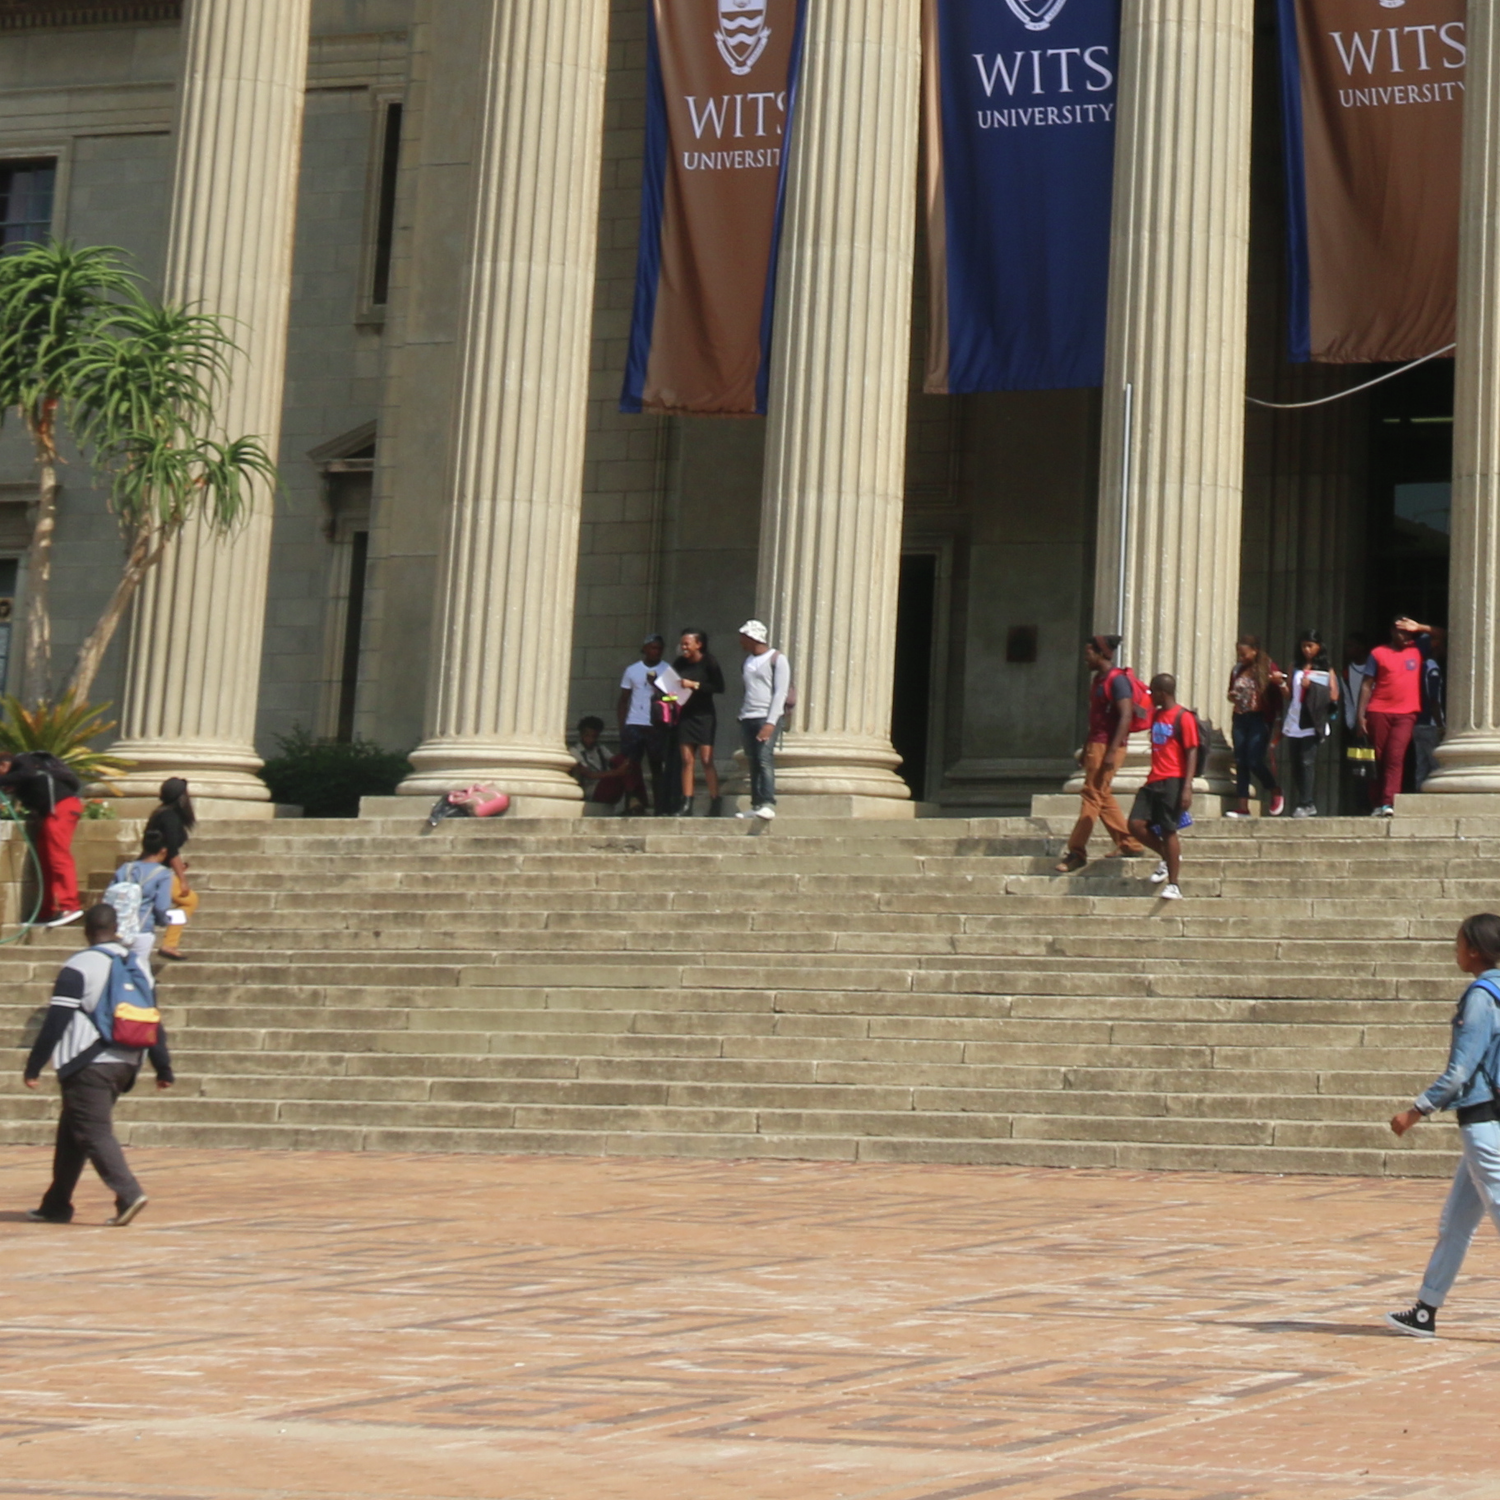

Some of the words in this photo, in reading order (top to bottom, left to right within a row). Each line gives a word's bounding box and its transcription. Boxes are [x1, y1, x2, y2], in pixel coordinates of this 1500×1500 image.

[972, 46, 1113, 97] WITS
[1329, 22, 1466, 76] WITS
[977, 103, 1114, 129] UNIVERSITY
